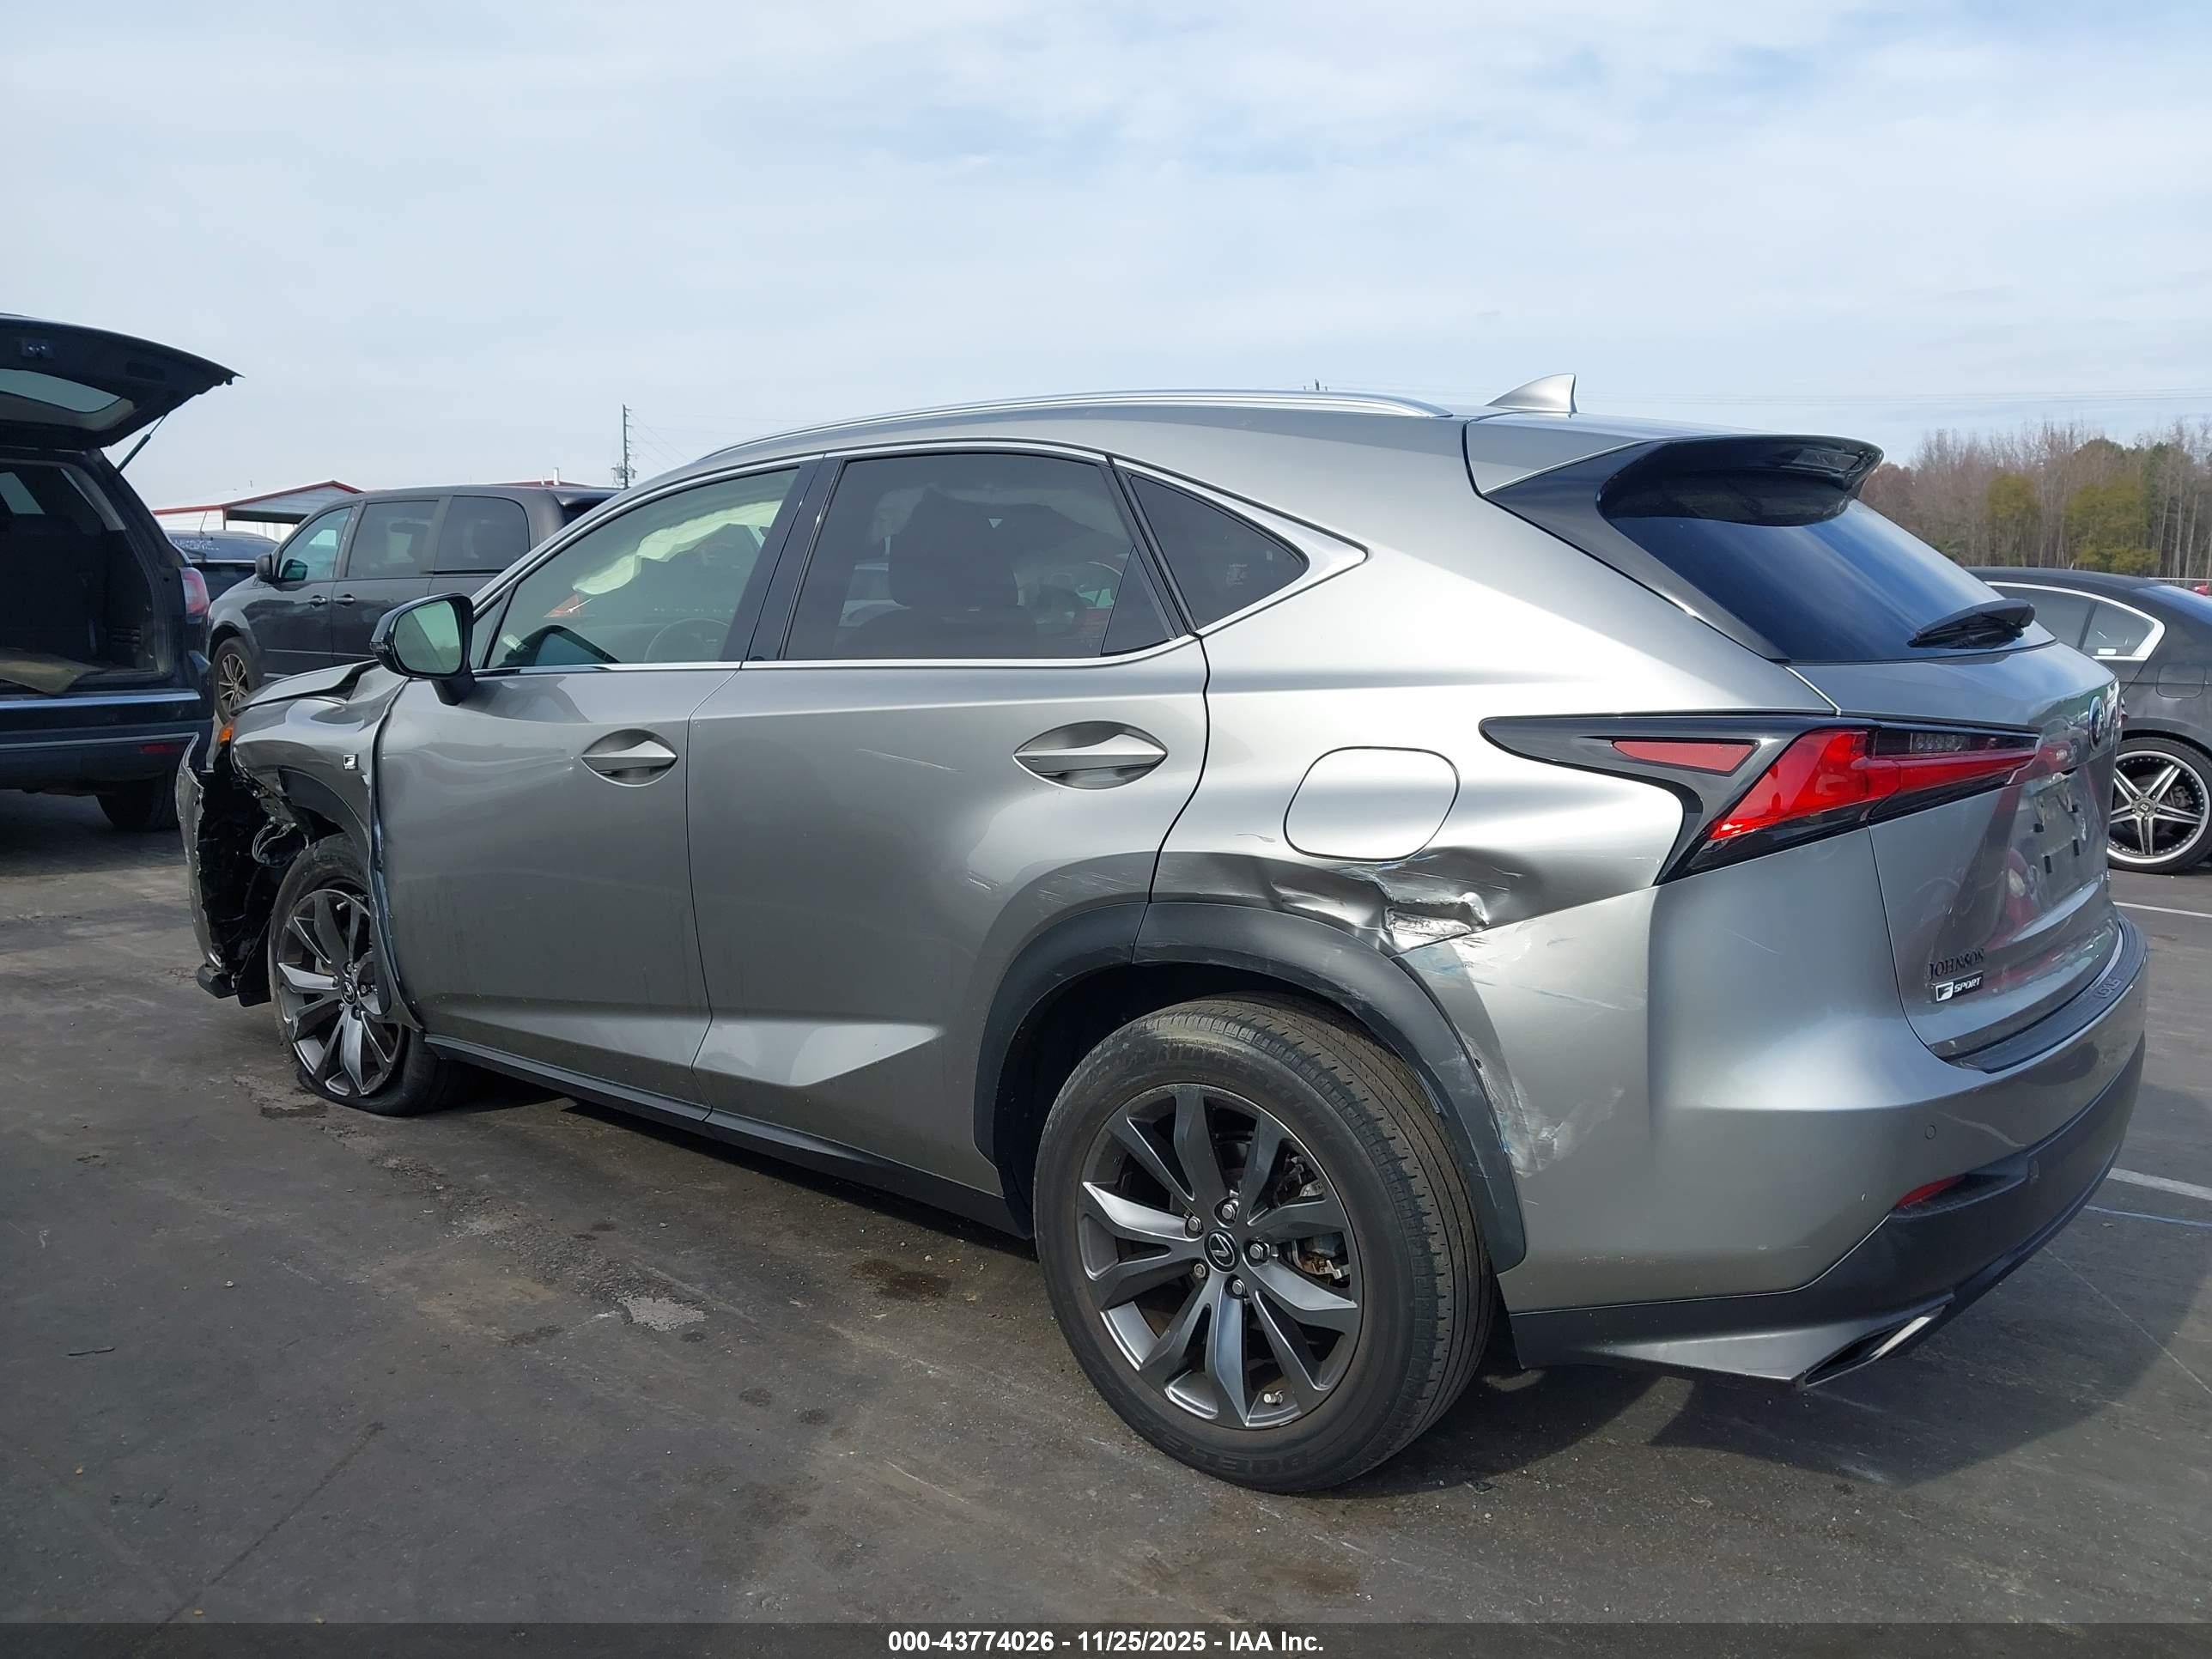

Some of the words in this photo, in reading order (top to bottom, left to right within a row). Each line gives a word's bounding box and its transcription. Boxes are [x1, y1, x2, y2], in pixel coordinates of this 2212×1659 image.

[1929, 948, 1984, 981] JOHNSON
[1936, 981, 1954, 1002] F
[1954, 976, 1982, 993] SPORT
